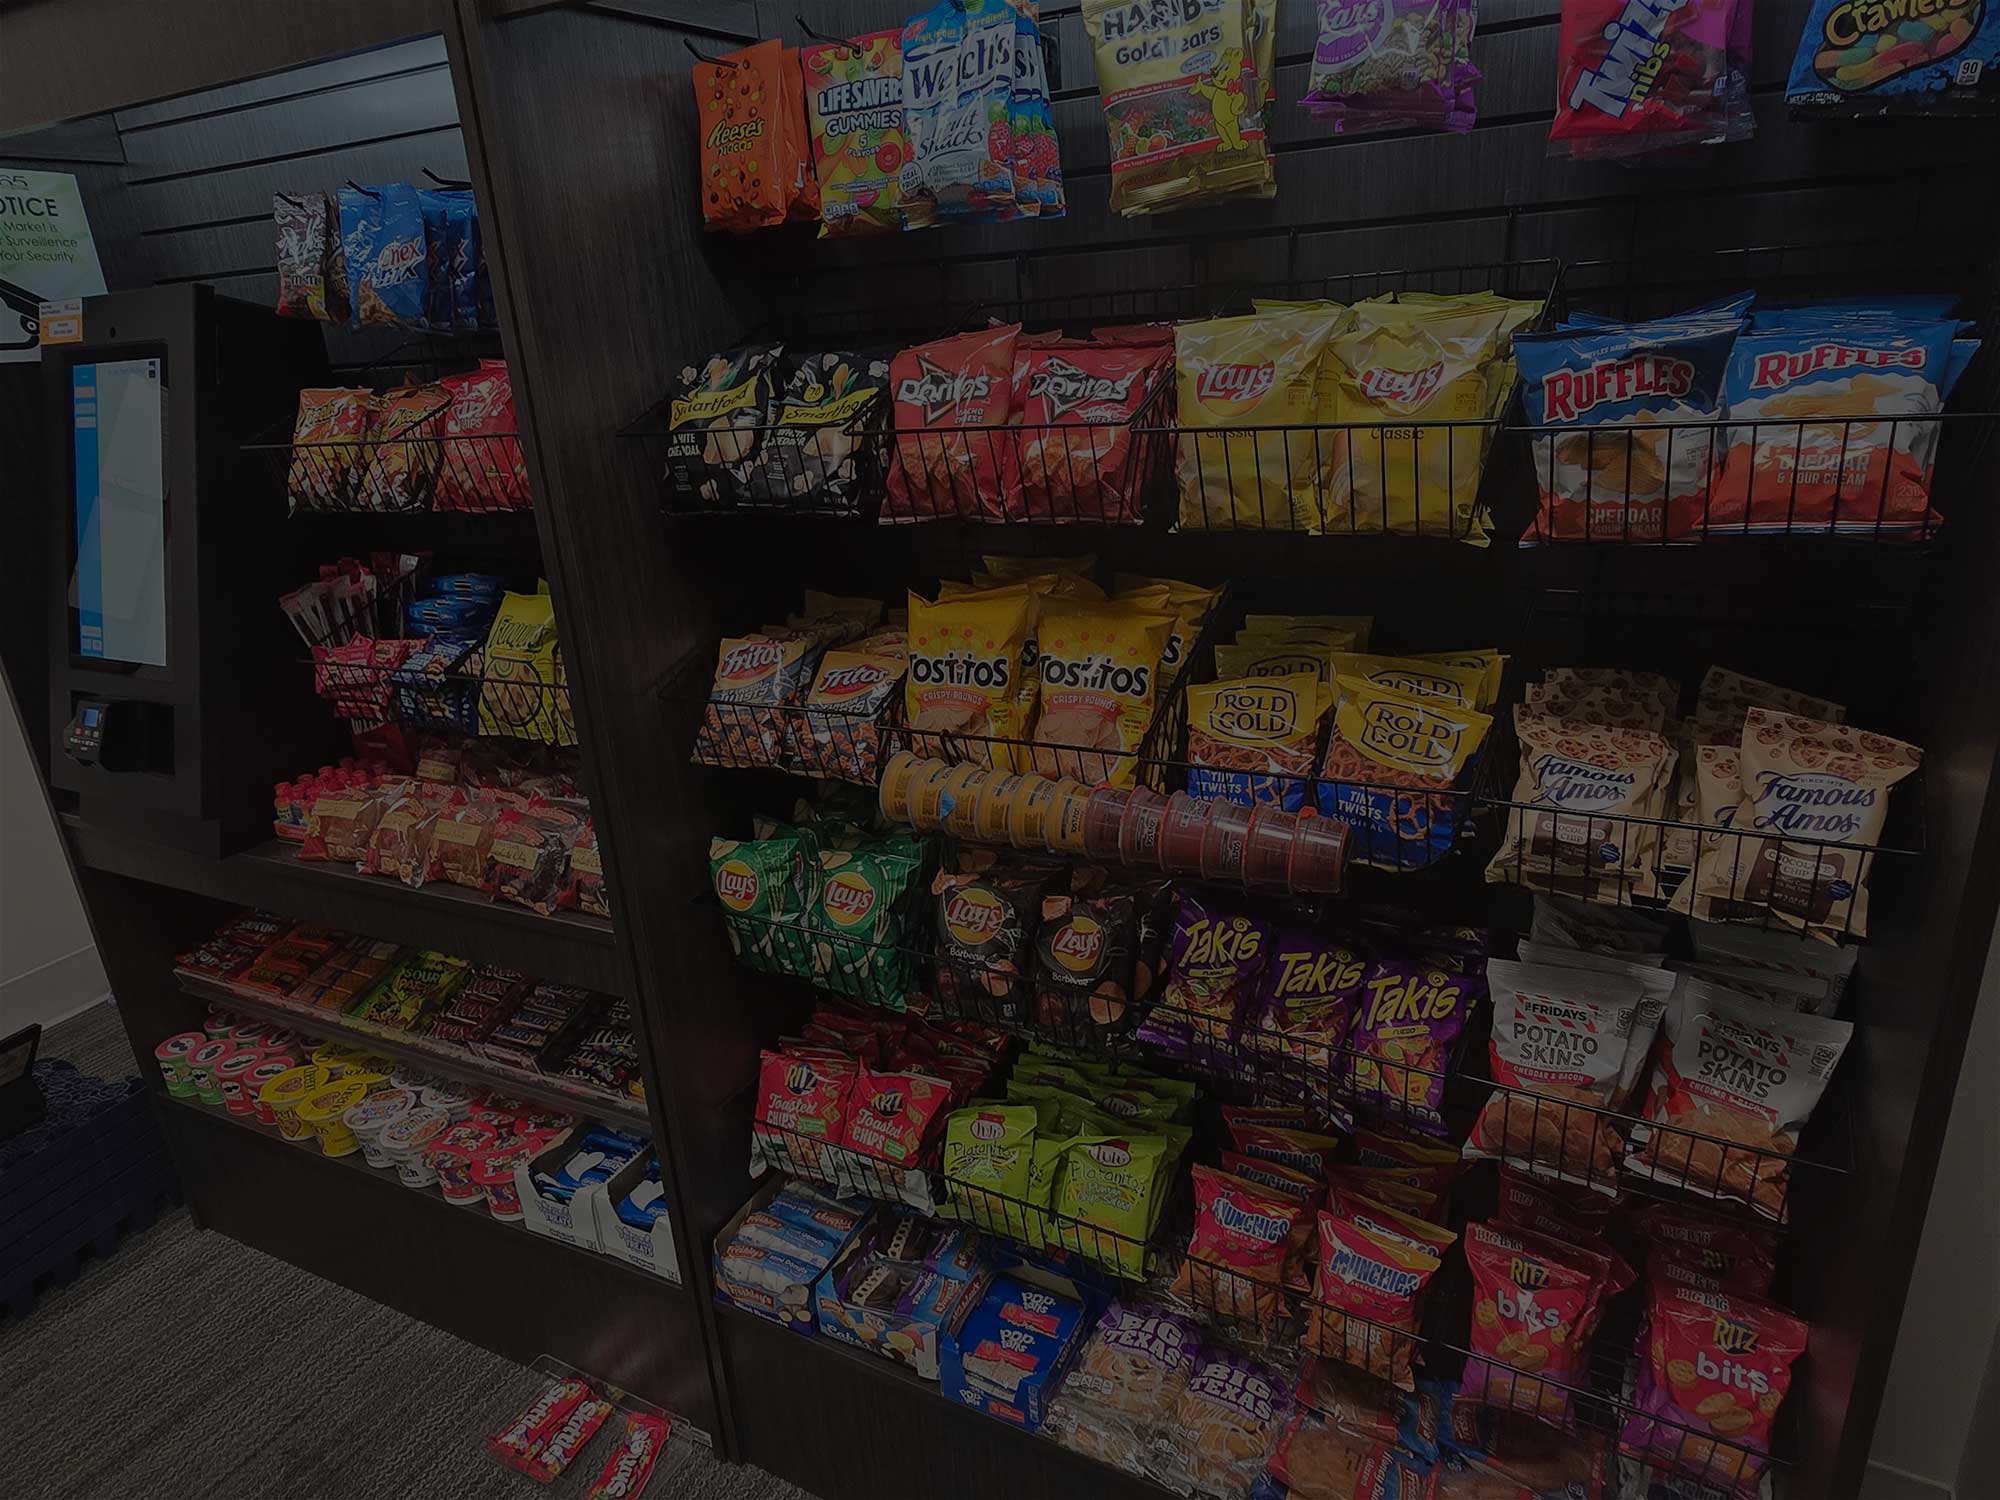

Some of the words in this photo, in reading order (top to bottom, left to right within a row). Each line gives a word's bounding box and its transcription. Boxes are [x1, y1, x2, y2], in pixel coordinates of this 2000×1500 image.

[1961, 61, 1978, 75] 90
[706, 117, 766, 149] Reese's
[825, 110, 902, 138] GUMMIES
[859, 134, 868, 148] 5
[4, 222, 46, 233] Market
[27, 251, 75, 264] Security
[1754, 344, 1928, 388] RUFFLES
[897, 372, 991, 406] Doritos
[1544, 354, 1696, 423] RUFFLES
[721, 645, 785, 681] Fritos
[818, 666, 889, 693] Fritos
[1224, 694, 1289, 714] ROLD
[1218, 712, 1288, 733] GOLD
[1375, 707, 1452, 741] ROLD
[1370, 724, 1444, 761] GOLD
[1199, 781, 1243, 795] TWISTS
[1531, 753, 1636, 792] Famous
[1753, 770, 1876, 808] Famous
[1349, 789, 1376, 806] TINY
[1531, 775, 1627, 806] Amos
[1337, 798, 1383, 821] TWISTS
[1753, 803, 1861, 833] Amos
[1179, 917, 1263, 968] Takis
[1273, 950, 1367, 998] Takis
[1363, 970, 1461, 1032] Takis
[1531, 1002, 1588, 1022] FRIDAYS
[1512, 1022, 1600, 1055] POTATO
[1519, 1041, 1587, 1068] SKINS
[1697, 1039, 1788, 1086] POTATO
[1700, 1060, 1771, 1100] SKINS
[852, 1126, 886, 1150] CHIPS
[1212, 1197, 1289, 1242] MUNCHIES
[1330, 1249, 1421, 1300] MUNCHIES
[1510, 1256, 1550, 1289] RITZ
[1119, 1311, 1184, 1348] BIG
[1712, 1315, 1761, 1353] RITZ
[1104, 1328, 1182, 1369] TEXAS
[1202, 1361, 1273, 1401] BIG
[1696, 1351, 1769, 1395] bits
[1187, 1374, 1274, 1423] TEXAS
